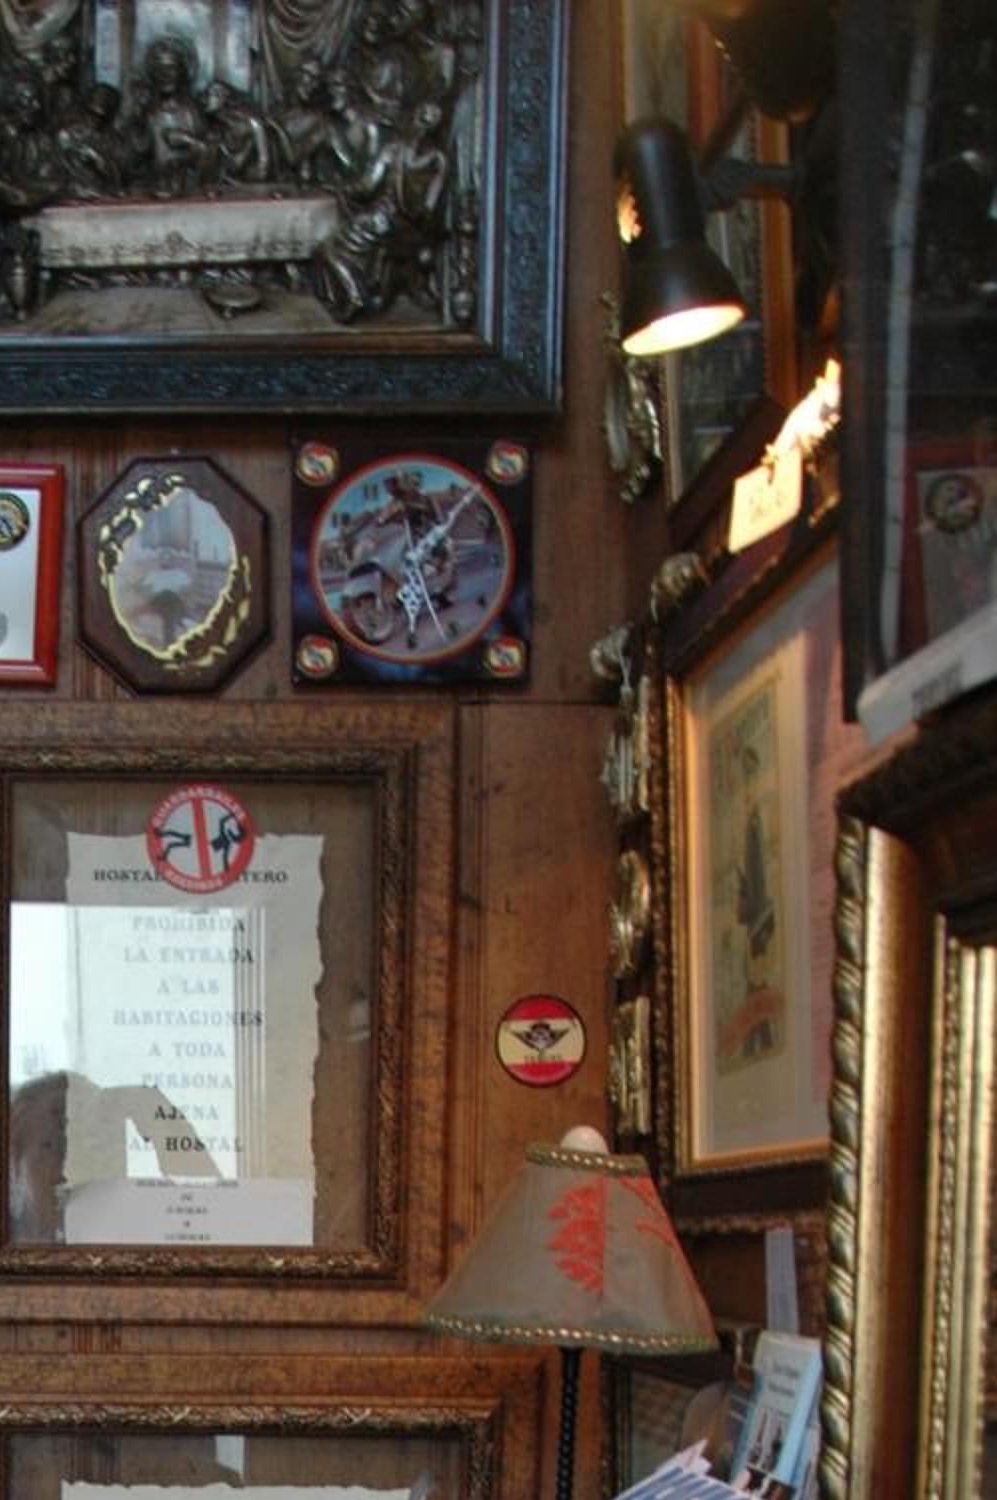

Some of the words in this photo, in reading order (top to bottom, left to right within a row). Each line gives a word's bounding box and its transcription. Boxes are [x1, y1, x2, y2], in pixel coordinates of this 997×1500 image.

[133, 915, 245, 932] PROHIBIDA
[124, 946, 148, 962] LA
[160, 946, 254, 963] ENTRADA
[182, 977, 219, 994] LAS
[174, 1041, 225, 1057] TODA
[165, 1135, 243, 1152] HOSTAL
